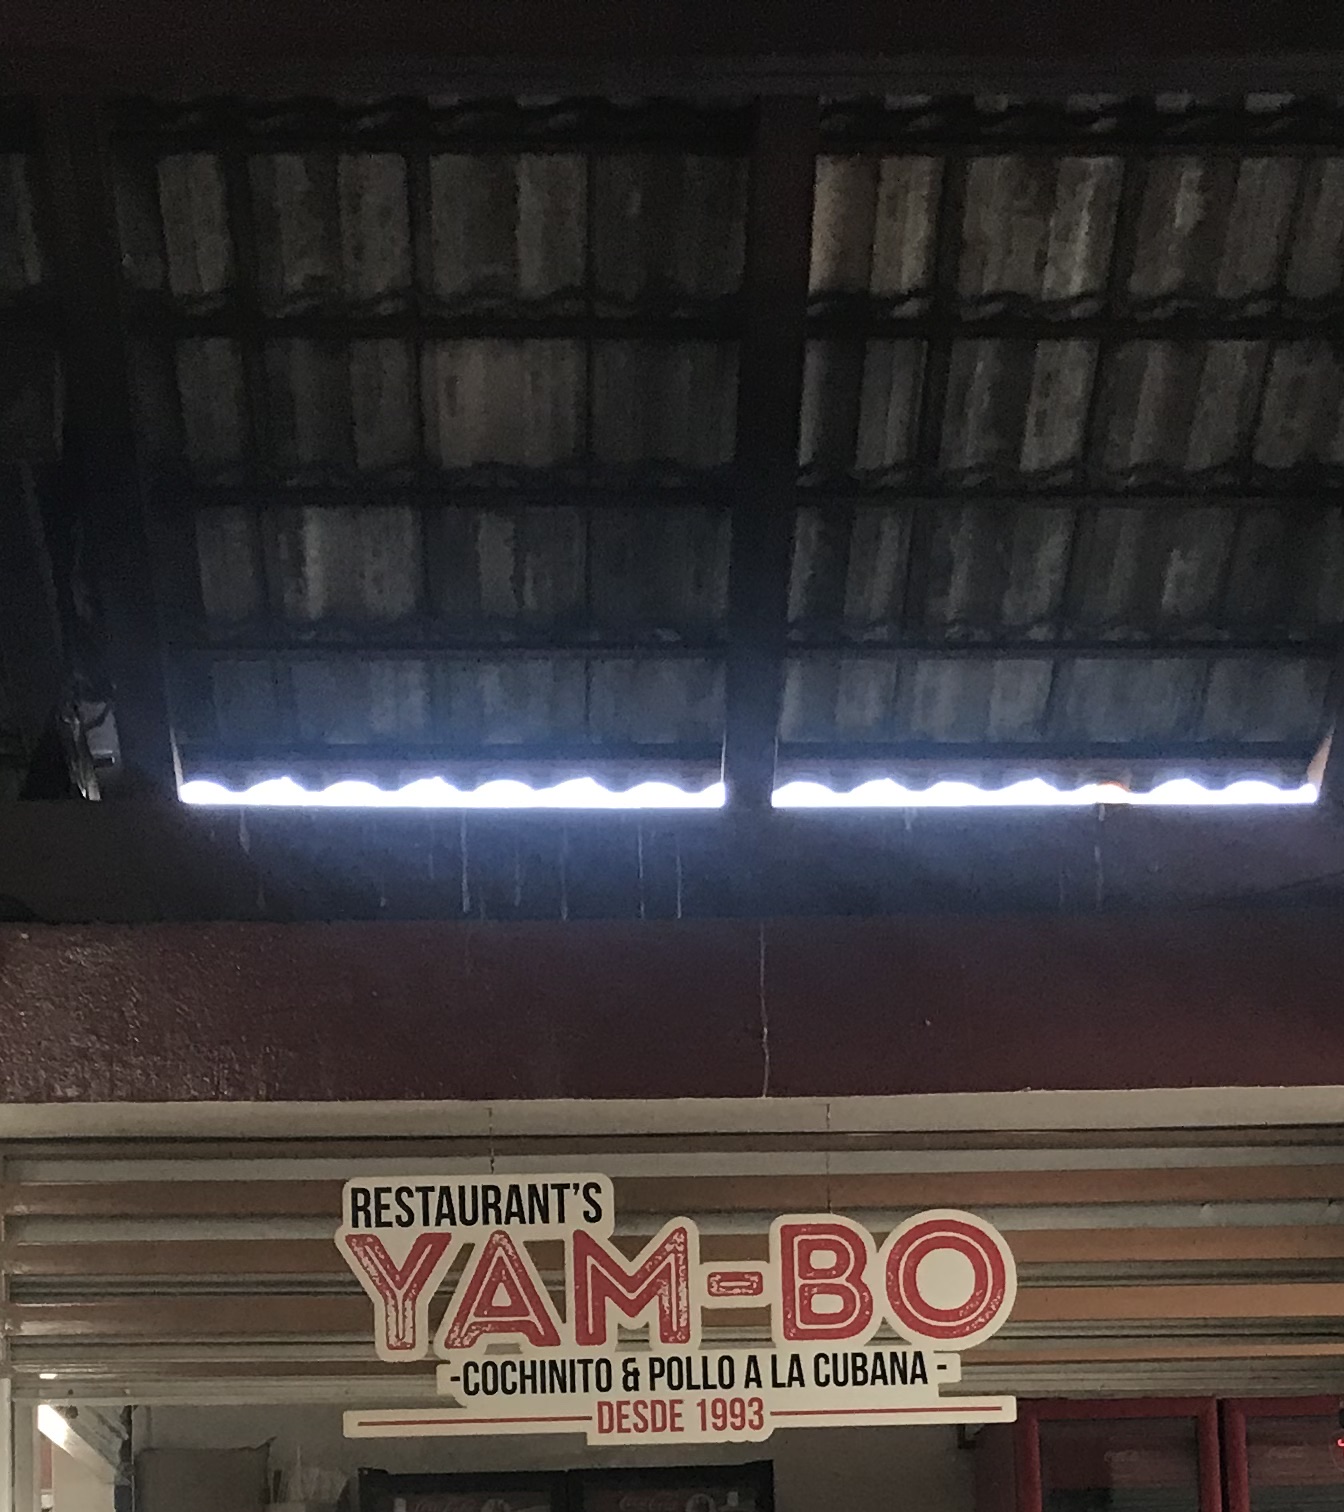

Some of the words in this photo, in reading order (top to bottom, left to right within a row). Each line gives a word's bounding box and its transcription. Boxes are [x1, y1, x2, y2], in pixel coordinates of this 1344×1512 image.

[350, 1181, 603, 1228] RESTAURANT'S
[346, 1218, 1007, 1351] YAM-BO
[622, 1358, 640, 1392] &
[649, 1355, 734, 1391] POLLO
[744, 1355, 762, 1388] A
[771, 1354, 805, 1388] LA
[598, 1402, 682, 1432] DESDE
[697, 1398, 763, 1430] 1993
